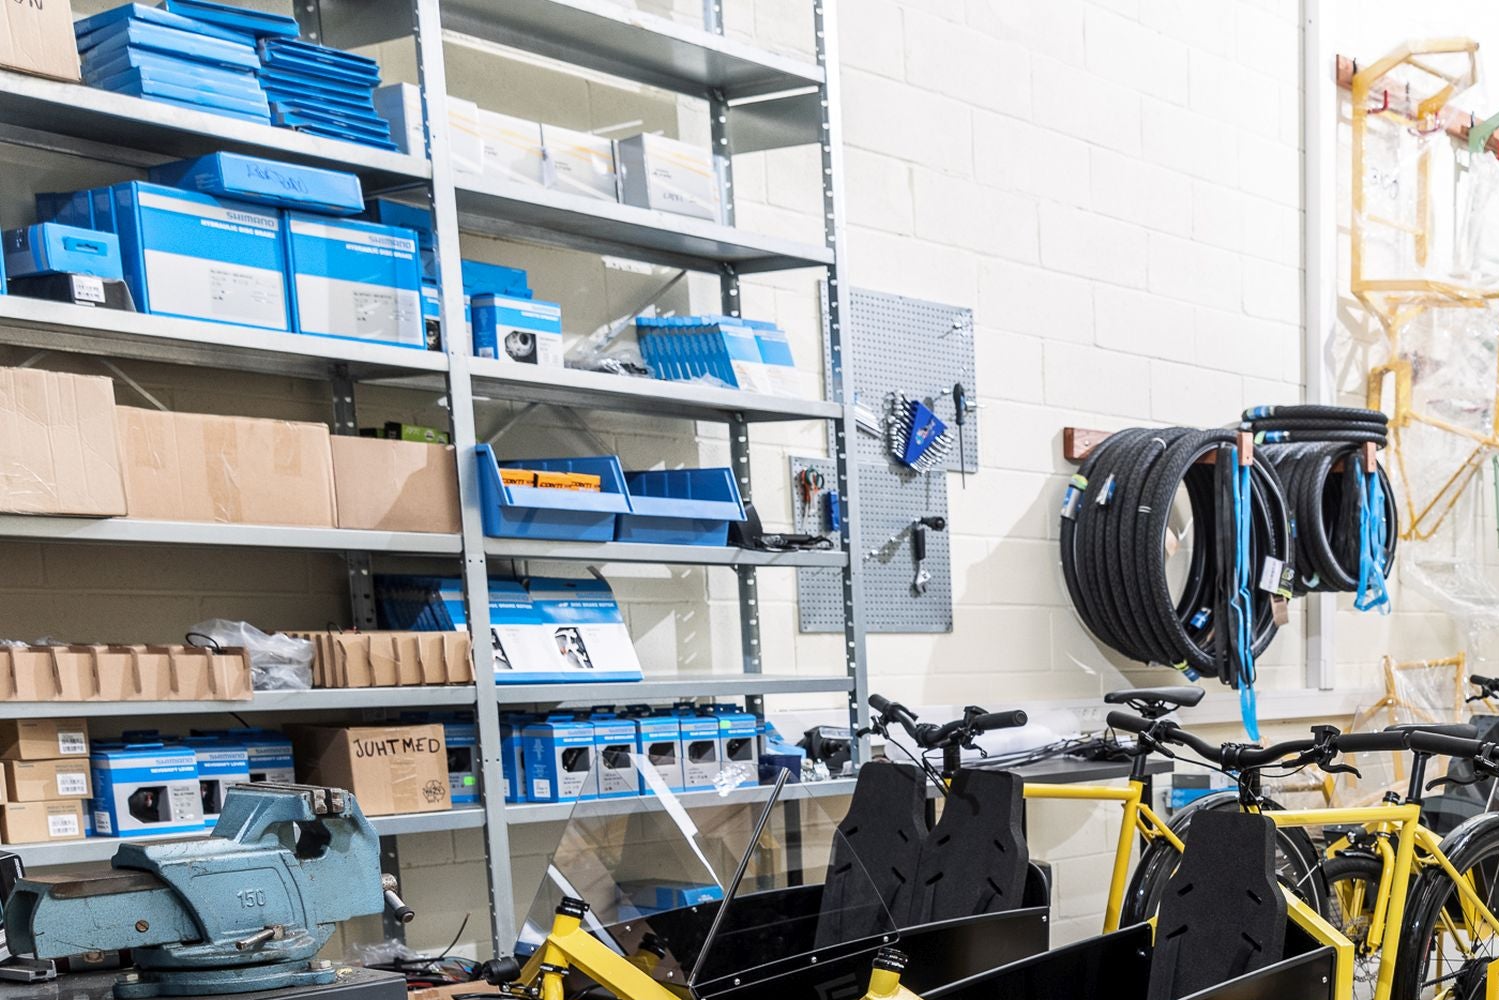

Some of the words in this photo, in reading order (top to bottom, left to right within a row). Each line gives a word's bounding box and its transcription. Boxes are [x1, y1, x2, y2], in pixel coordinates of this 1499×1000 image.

[225, 210, 276, 228] SHIMANO
[352, 736, 441, 759] JUHTMED
[236, 888, 266, 909] 150
